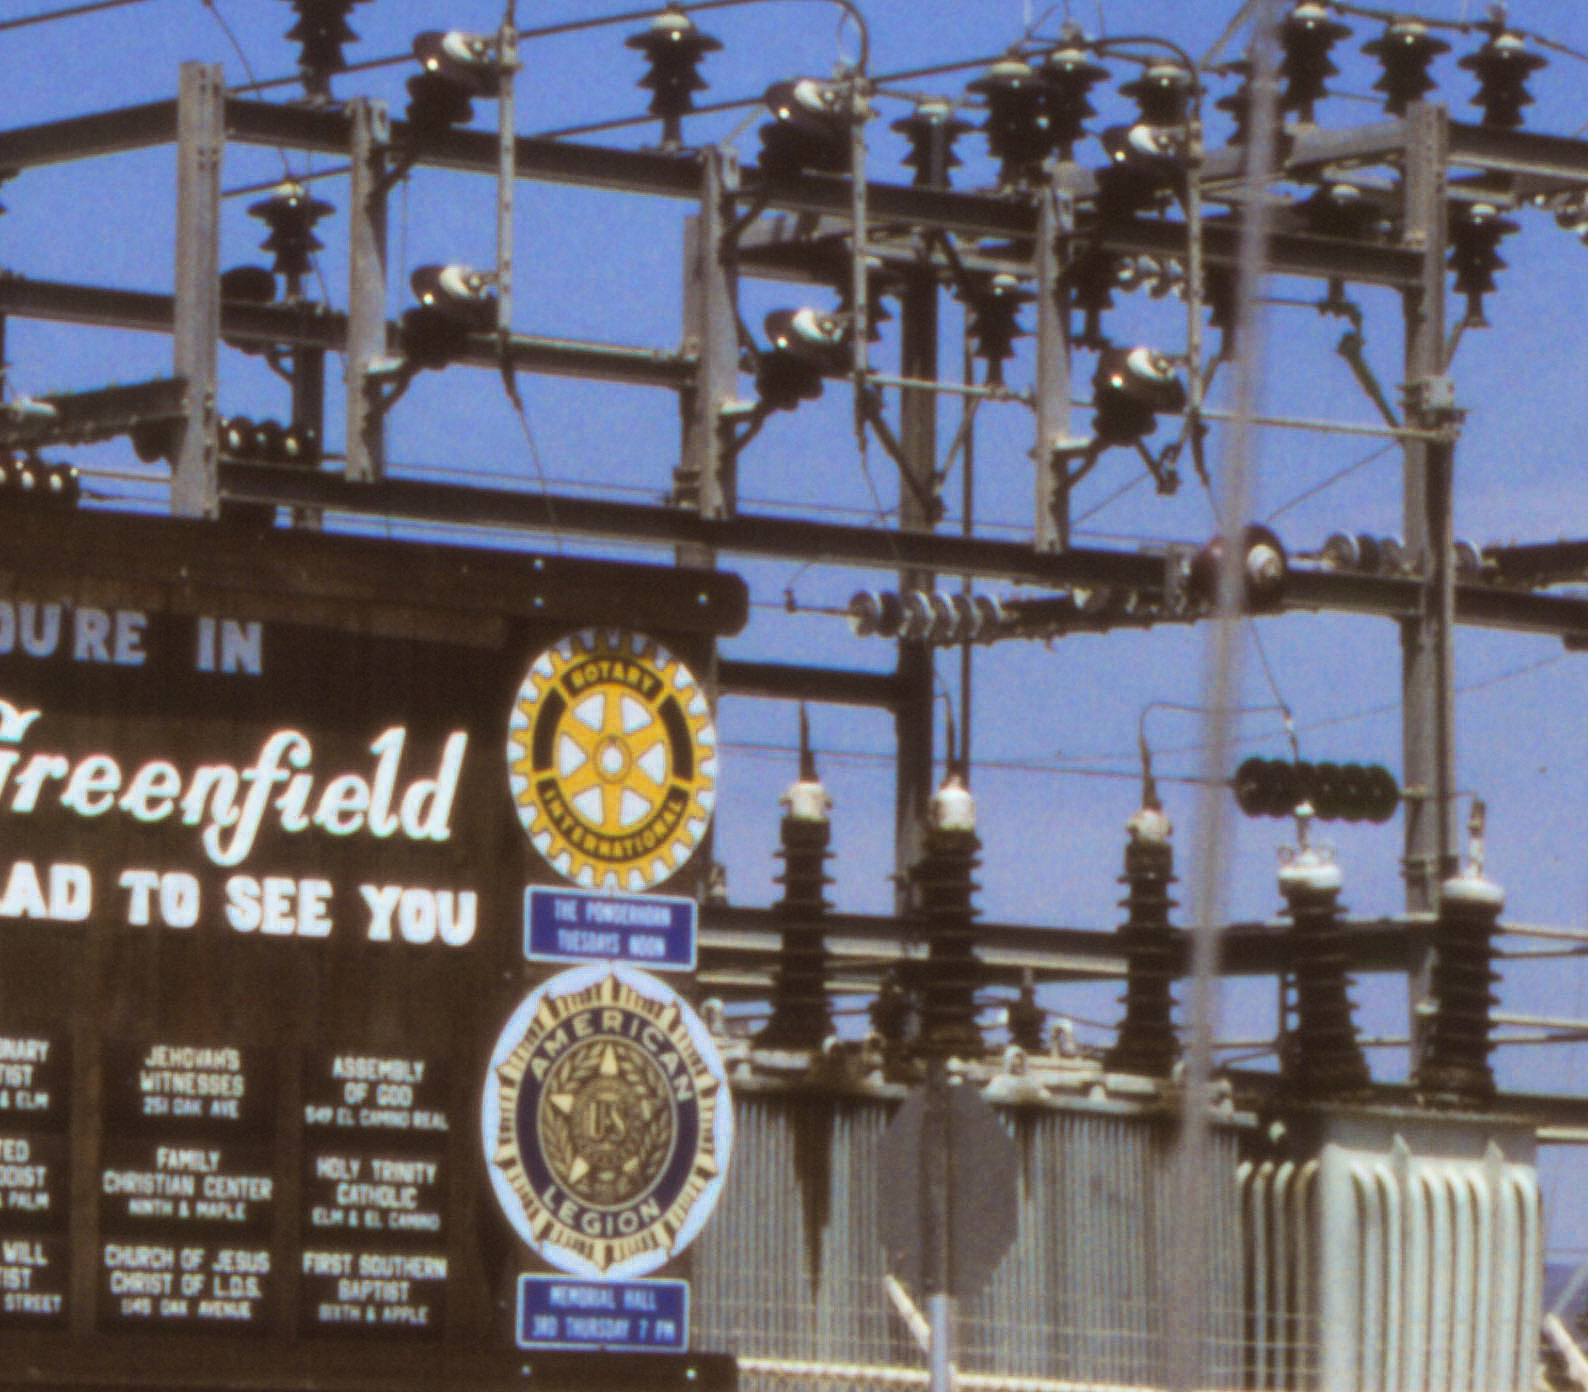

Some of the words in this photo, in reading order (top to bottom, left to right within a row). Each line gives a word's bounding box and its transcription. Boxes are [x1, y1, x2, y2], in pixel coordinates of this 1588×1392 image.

[197, 617, 264, 676] IN
[572, 662, 653, 692] ROTARY
[544, 784, 683, 858] INTERNATIONAL
[118, 870, 201, 929] TO
[225, 875, 334, 939] SEE
[359, 883, 478, 947] YOU
[554, 898, 578, 922] THE
[557, 928, 621, 956] TUESDAYS
[628, 933, 666, 958] NOON
[145, 1044, 241, 1072] JEHOVAH'S
[332, 1056, 424, 1083] ASSEMBLY
[529, 1010, 694, 1103] AMERICAN
[139, 1070, 245, 1098] WITNESSES
[343, 1082, 369, 1105] OF
[377, 1083, 413, 1108] GOD
[15, 1090, 49, 1110] ELM
[173, 1097, 203, 1117] OAK
[211, 1099, 239, 1120] AVE
[336, 1107, 355, 1127] EL
[359, 1108, 410, 1129] CAMINO
[412, 1110, 449, 1131] REAL
[156, 1146, 220, 1172] FAMILY
[316, 1157, 360, 1181] HOLY
[371, 1159, 437, 1184] TRINITY
[102, 1169, 195, 1196] CHRISTIAN
[203, 1174, 273, 1200] CENTER
[337, 1182, 418, 1210] CATHOLIC
[8, 1190, 50, 1209] PALM
[128, 1198, 173, 1217] NINTH
[179, 1200, 190, 1218] &
[196, 1201, 245, 1220] MAPLE
[542, 1184, 660, 1236] LEGION
[312, 1207, 345, 1227] ELM
[348, 1209, 359, 1228] &
[388, 1212, 440, 1231] CAMINO
[2, 1239, 48, 1268] WILL
[105, 1243, 174, 1270] CHURCH
[180, 1247, 204, 1272] OF
[212, 1249, 270, 1275] JESUS
[302, 1250, 352, 1277] FIRST
[359, 1253, 447, 1280] SOUTHERN
[110, 1270, 172, 1296] CHRIST
[181, 1272, 205, 1297] OF
[338, 1278, 410, 1303] BAPTIST
[4, 1292, 62, 1314] STREET
[160, 1298, 188, 1317] OAK
[198, 1299, 251, 1319] AVENUE
[549, 1285, 616, 1310] MEMORIAL
[624, 1289, 657, 1312] HALL
[366, 1304, 376, 1324] &
[382, 1306, 428, 1326] APPLE
[638, 1317, 649, 1342] 7
[655, 1319, 676, 1344] PM
